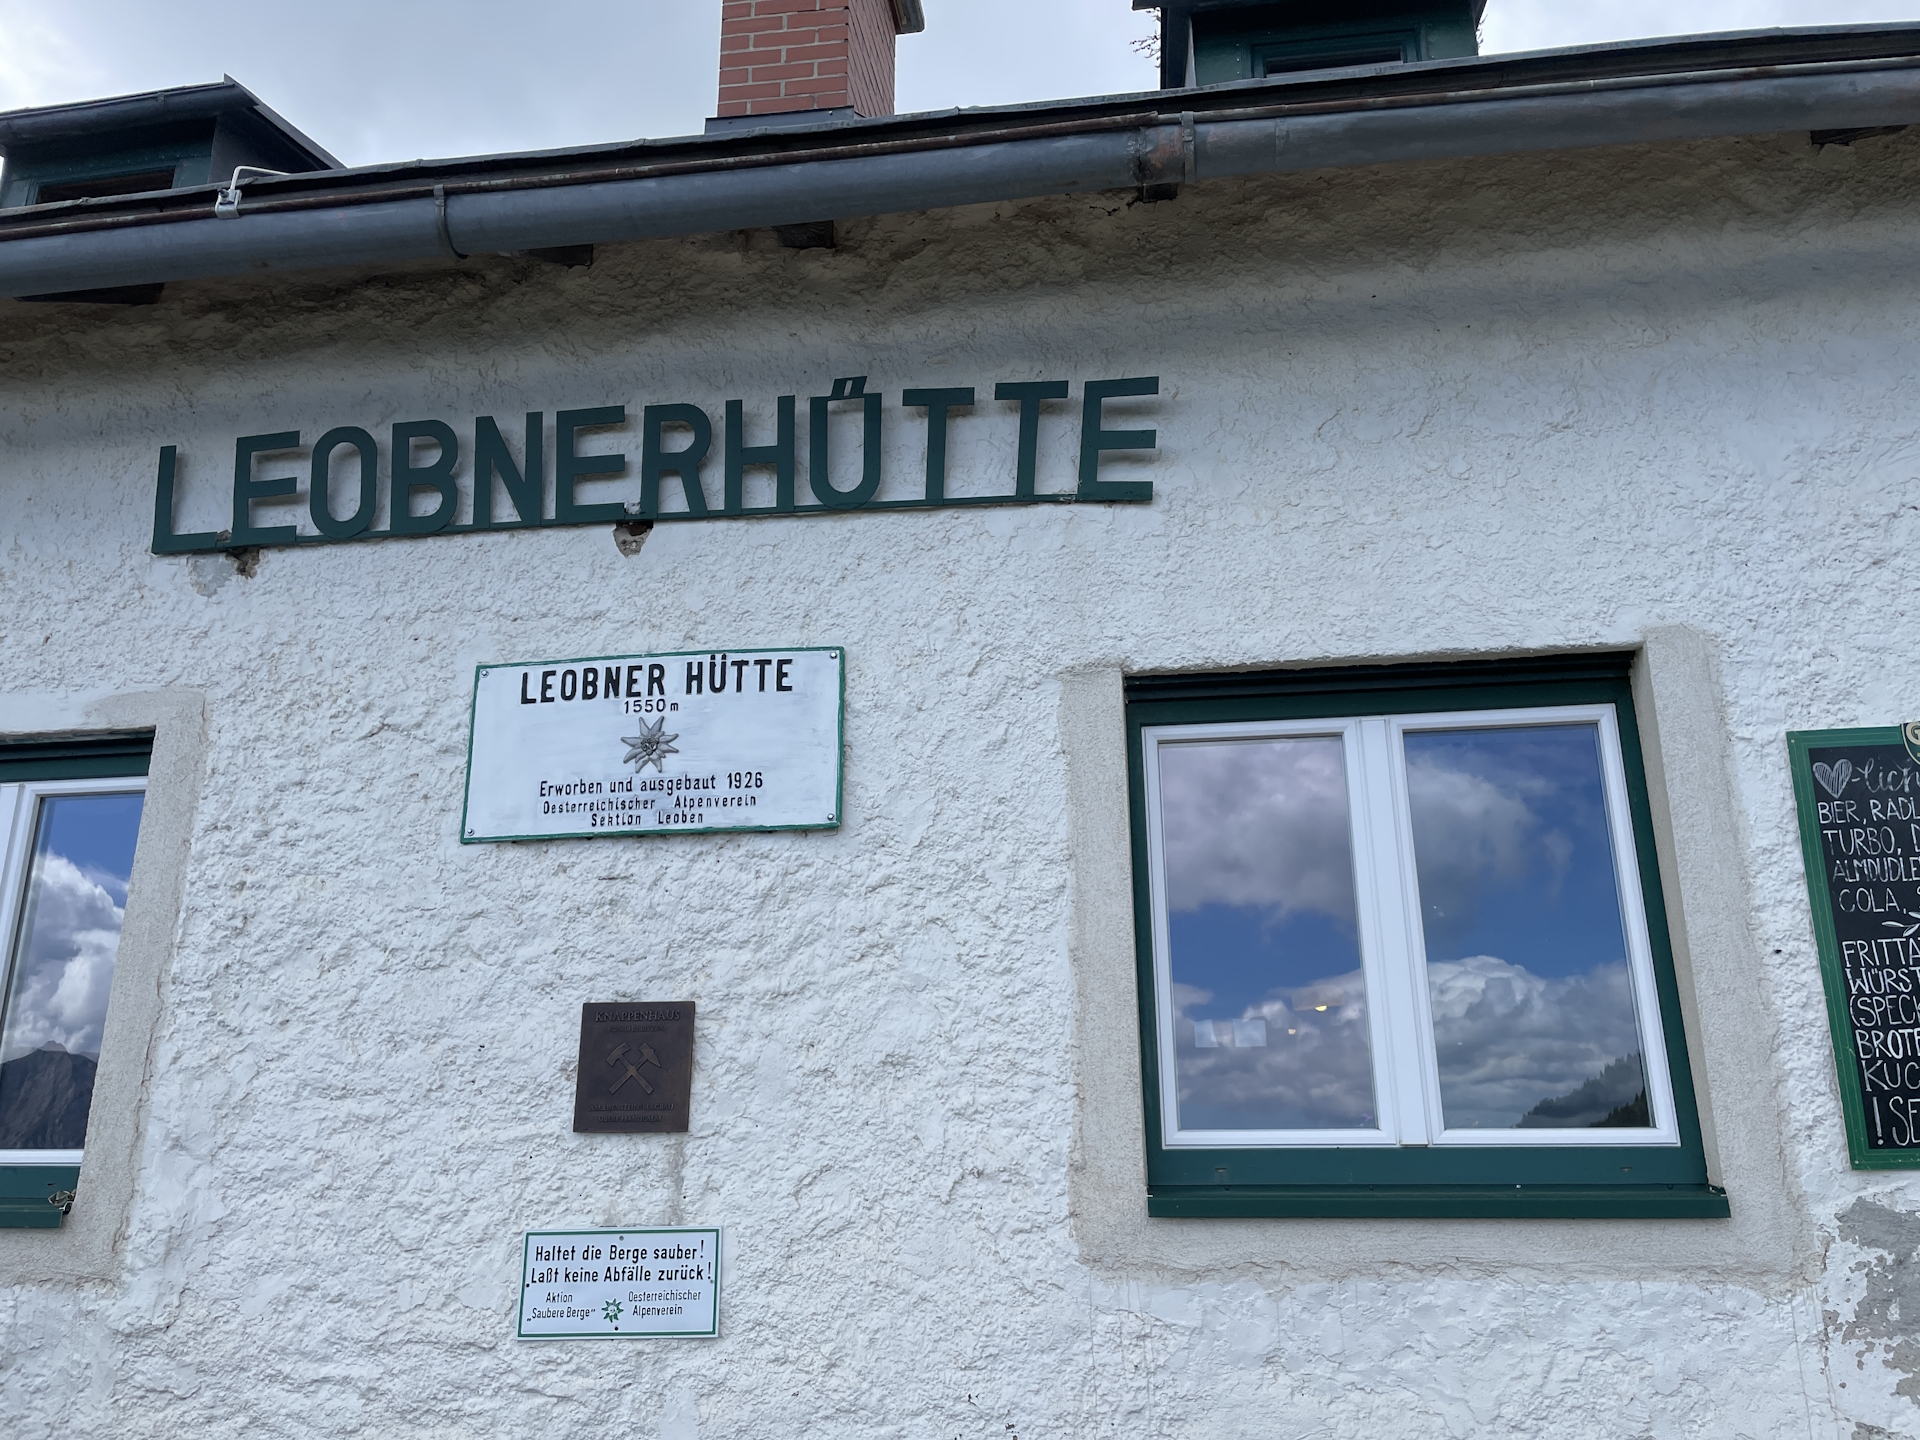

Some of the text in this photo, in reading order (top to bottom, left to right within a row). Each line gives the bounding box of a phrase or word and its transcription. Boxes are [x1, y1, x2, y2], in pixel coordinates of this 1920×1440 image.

[151, 376, 1159, 555] LEOBNERHÜTTE
[521, 653, 793, 704] LEOBNER HÜTTE
[625, 697, 678, 714] 1550 m
[540, 772, 762, 797] Erworben und ausgebaut 1926
[543, 795, 756, 815] Oesterreichischer Alpenverein
[1817, 801, 1867, 825] BIER,
[592, 809, 702, 827] Sektion Leoben
[1823, 826, 1901, 856] TURBO,
[1832, 857, 1920, 883] ALMDUDLE
[1839, 888, 1906, 914] COLA,
[1842, 938, 1920, 967] FRITTA
[595, 1010, 680, 1021] KNAPPENHAUS
[536, 1240, 703, 1263] Haltet die Berge sauber!
[531, 1262, 711, 1283] Laßt keine Abfälle zurück!
[546, 1292, 572, 1303] Aktion
[629, 1289, 701, 1302] Oesterreichischer
[633, 1305, 682, 1318] Alpenverein
